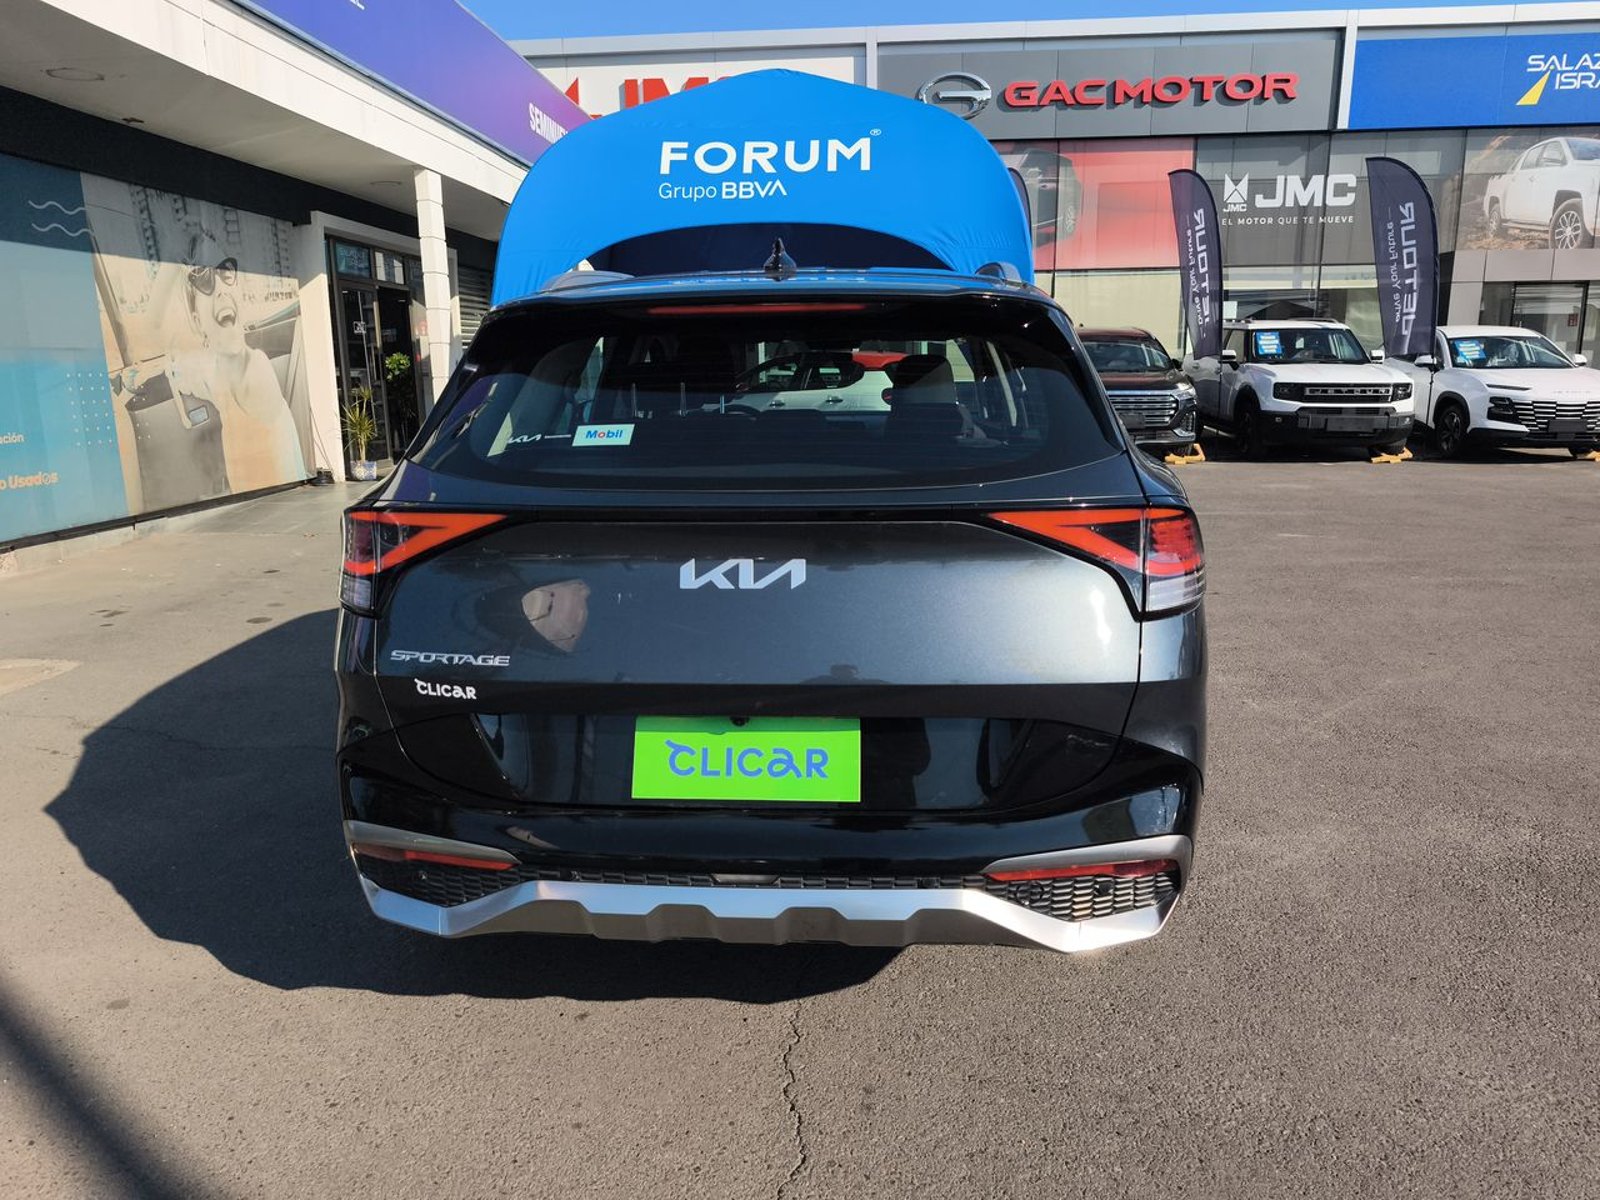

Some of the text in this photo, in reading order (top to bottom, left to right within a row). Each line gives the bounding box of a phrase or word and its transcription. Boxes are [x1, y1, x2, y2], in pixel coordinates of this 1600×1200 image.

[1004, 73, 1299, 107] GAC MOTOR
[658, 179, 788, 202] Grupo BBVA
[1255, 174, 1357, 208] JMC
[1222, 203, 1248, 213] JMC
[1221, 215, 1354, 226] EL MOTOR QUE TE MUEVE
[585, 429, 624, 439] Mobil
[8, 471, 59, 489] Usados
[679, 558, 806, 589] KIA
[390, 649, 511, 667] SPORTAGE
